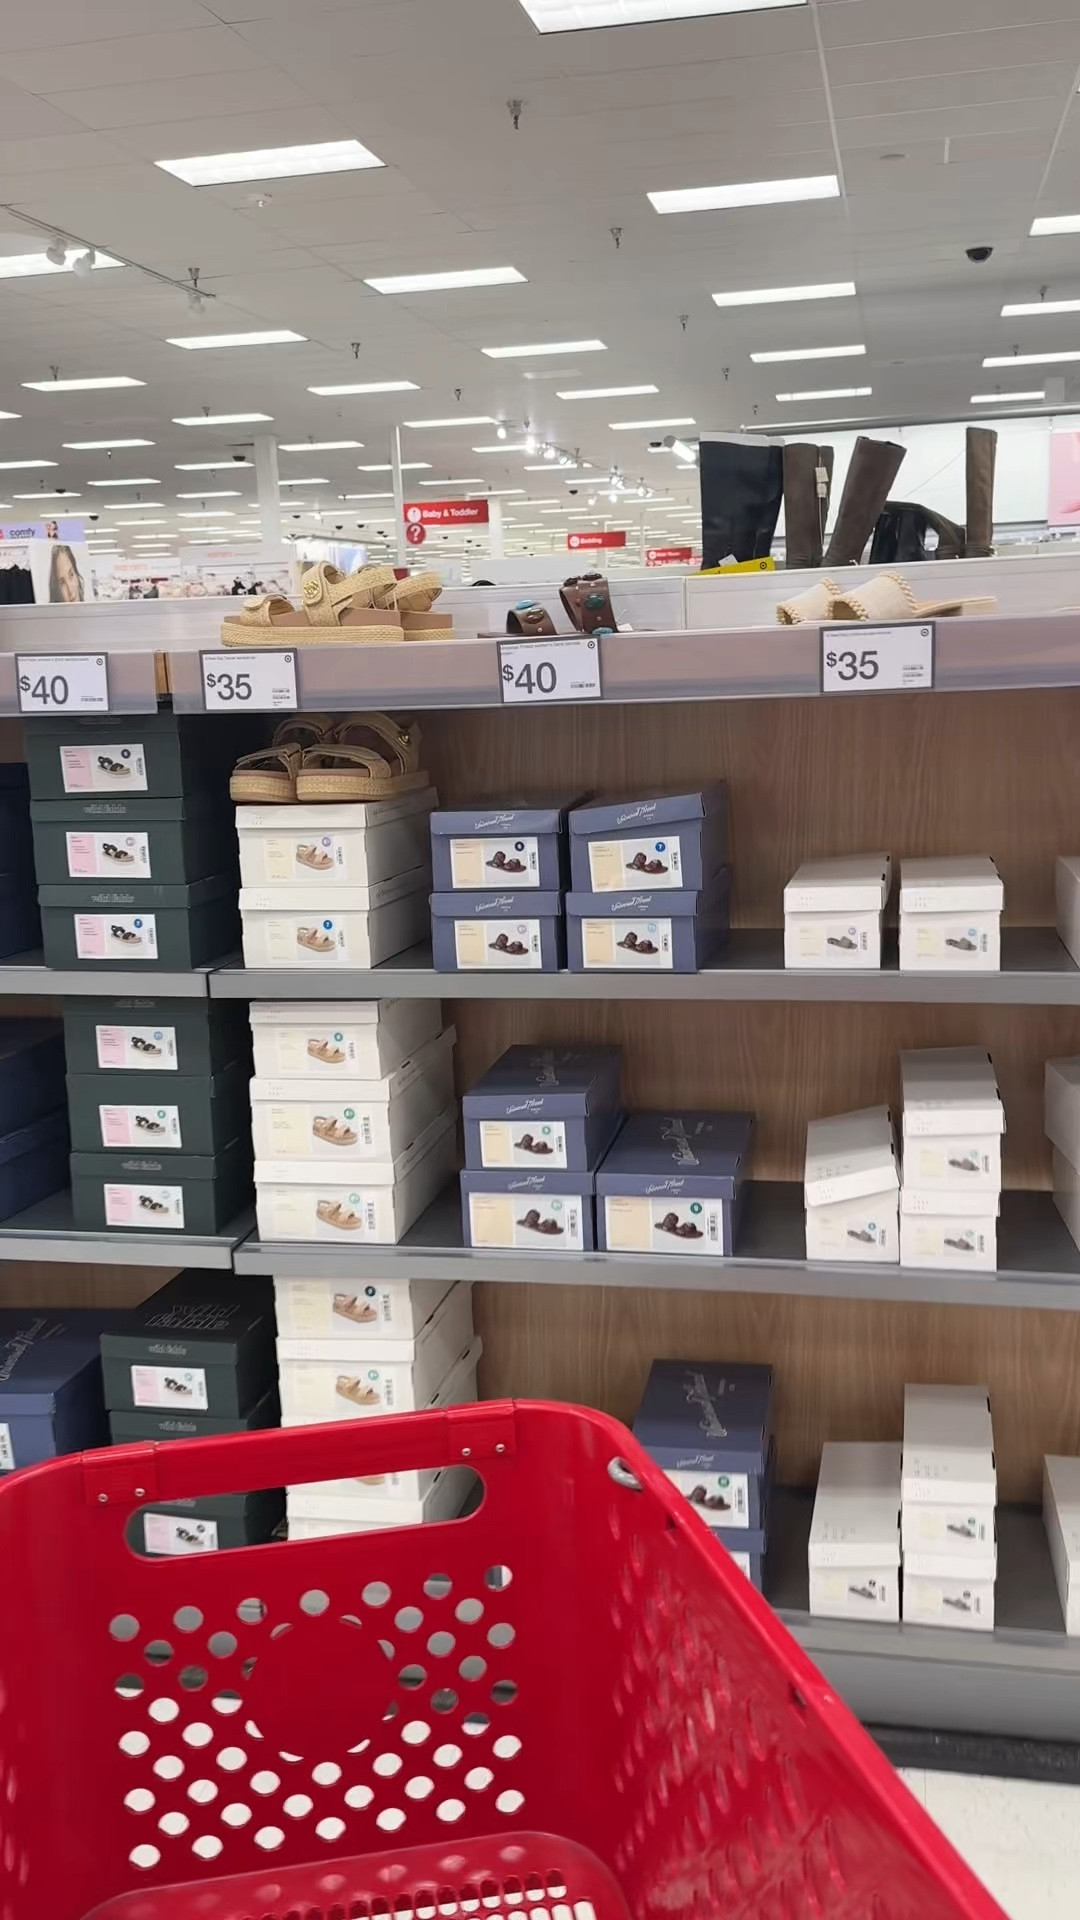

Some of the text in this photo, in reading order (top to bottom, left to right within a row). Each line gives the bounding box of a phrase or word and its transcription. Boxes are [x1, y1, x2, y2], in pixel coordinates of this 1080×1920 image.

[422, 508, 479, 519] Baby & Toddler
[9, 528, 36, 537] comfy
[502, 661, 558, 695] $40
[826, 650, 880, 682] $35
[19, 675, 69, 705] $40
[206, 673, 253, 701] $35
